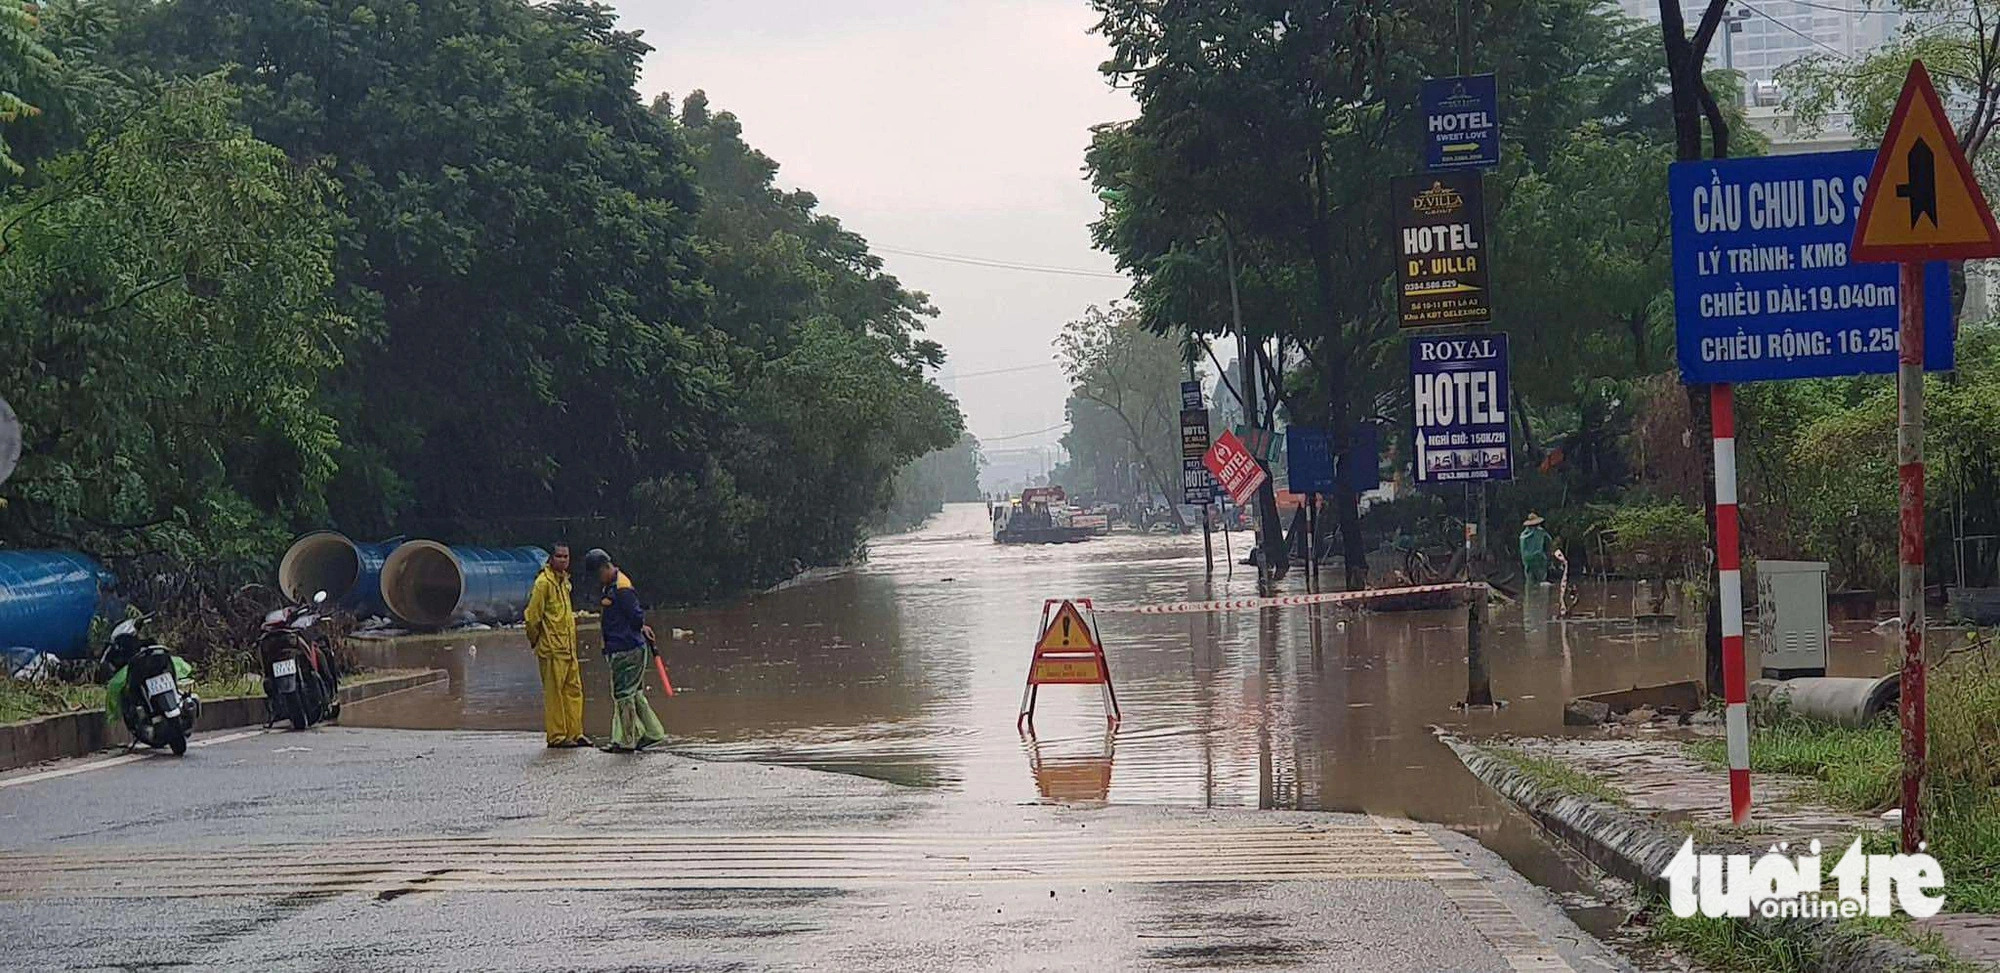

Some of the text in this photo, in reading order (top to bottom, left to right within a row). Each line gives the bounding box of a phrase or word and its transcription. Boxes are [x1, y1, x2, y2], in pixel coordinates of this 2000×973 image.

[1429, 112, 1493, 132] HOTEL
[1436, 131, 1487, 141] SWEET LOVE
[1693, 169, 1741, 233] CẦU
[1750, 180, 1805, 230] CHUI
[1812, 177, 1845, 225] DS
[1403, 224, 1479, 255] HOTEL
[1698, 242, 1847, 276] LÝ TRÌNH: KM8
[1700, 281, 1760, 318] CHIỀU
[1420, 340, 1496, 360] ROYAL
[1701, 326, 1899, 362] CHIỀU RỘNG: 16.25
[1415, 371, 1505, 426] HOTEL
[1183, 425, 1207, 435] HOTEL
[1185, 470, 1208, 488] HOTE
[1219, 451, 1247, 483] HOTEL
